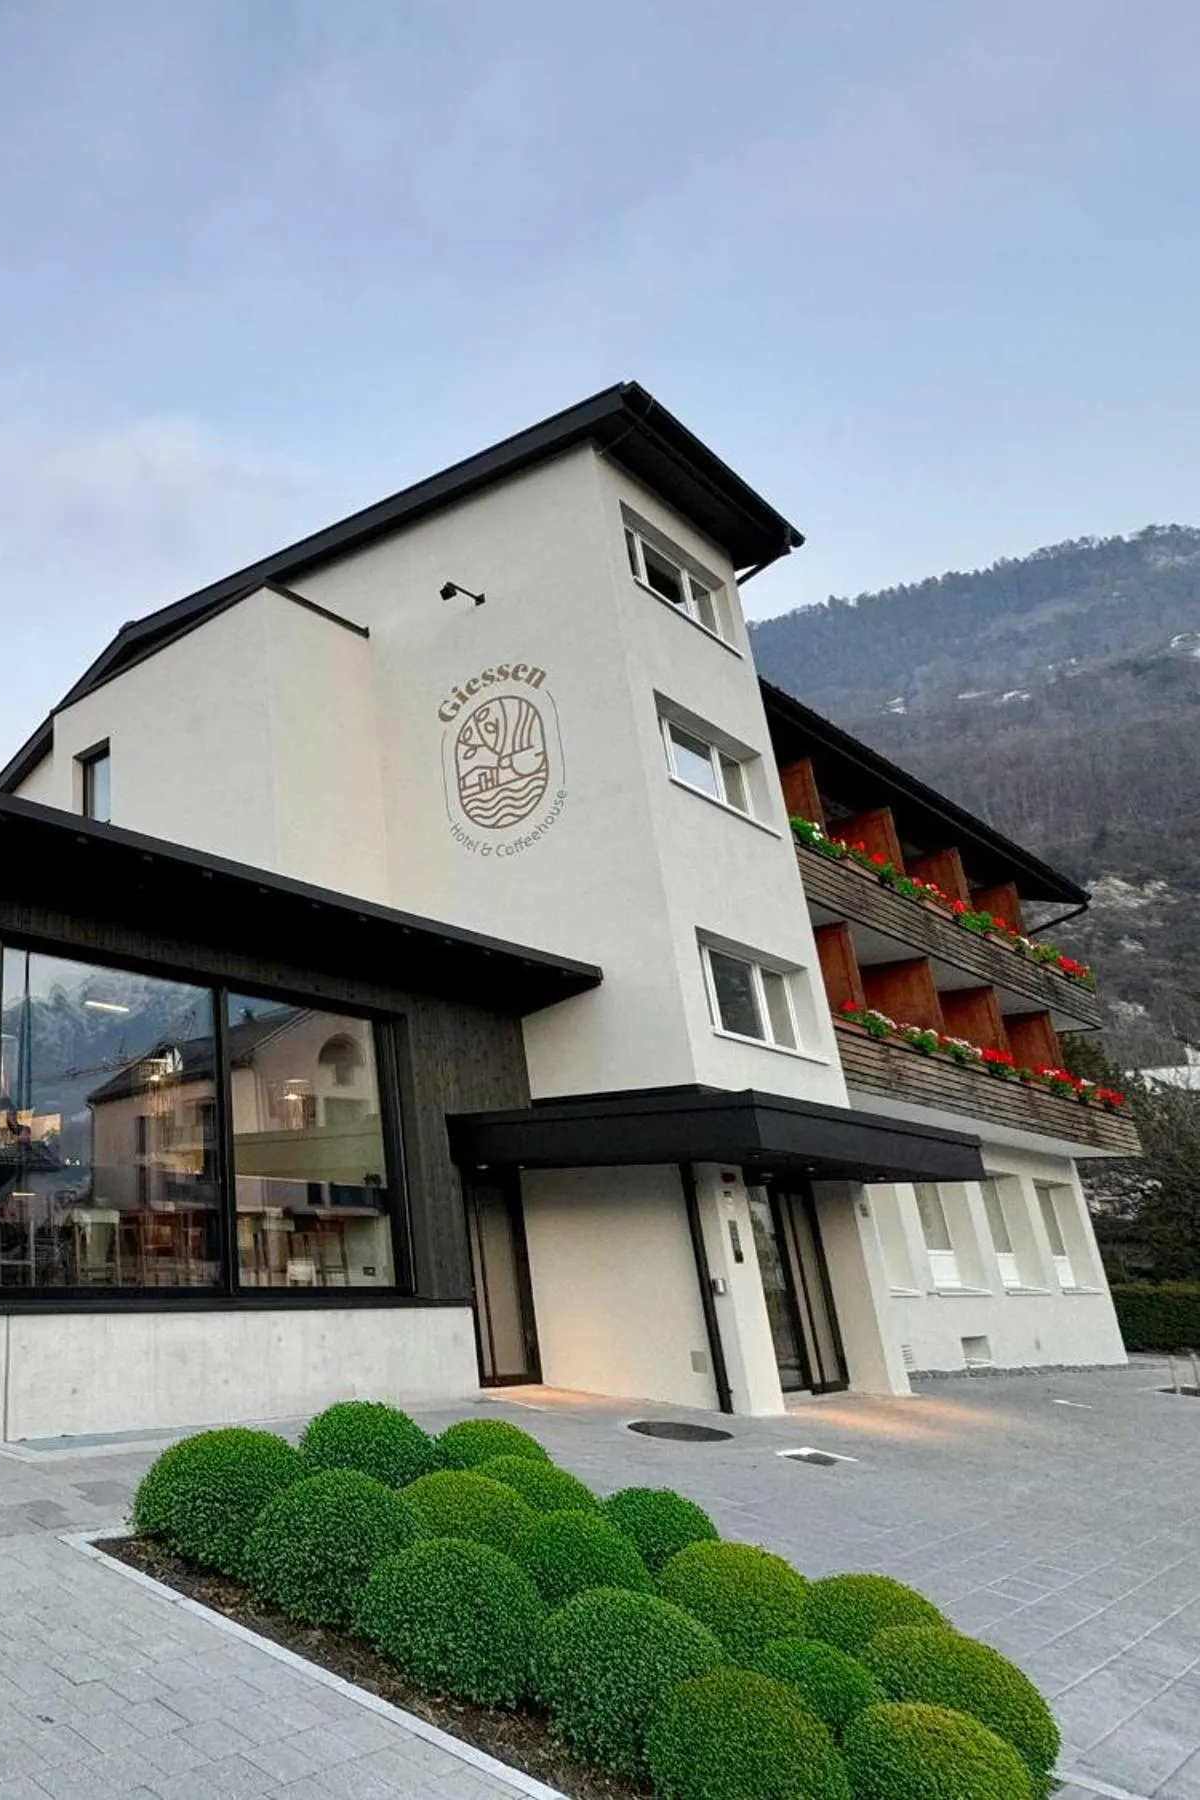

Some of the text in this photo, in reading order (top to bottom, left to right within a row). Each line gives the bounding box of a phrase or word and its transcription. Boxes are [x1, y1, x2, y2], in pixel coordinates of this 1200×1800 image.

[438, 663, 547, 722] Giessen
[450, 789, 568, 857] Hotel & Coffeehouse
